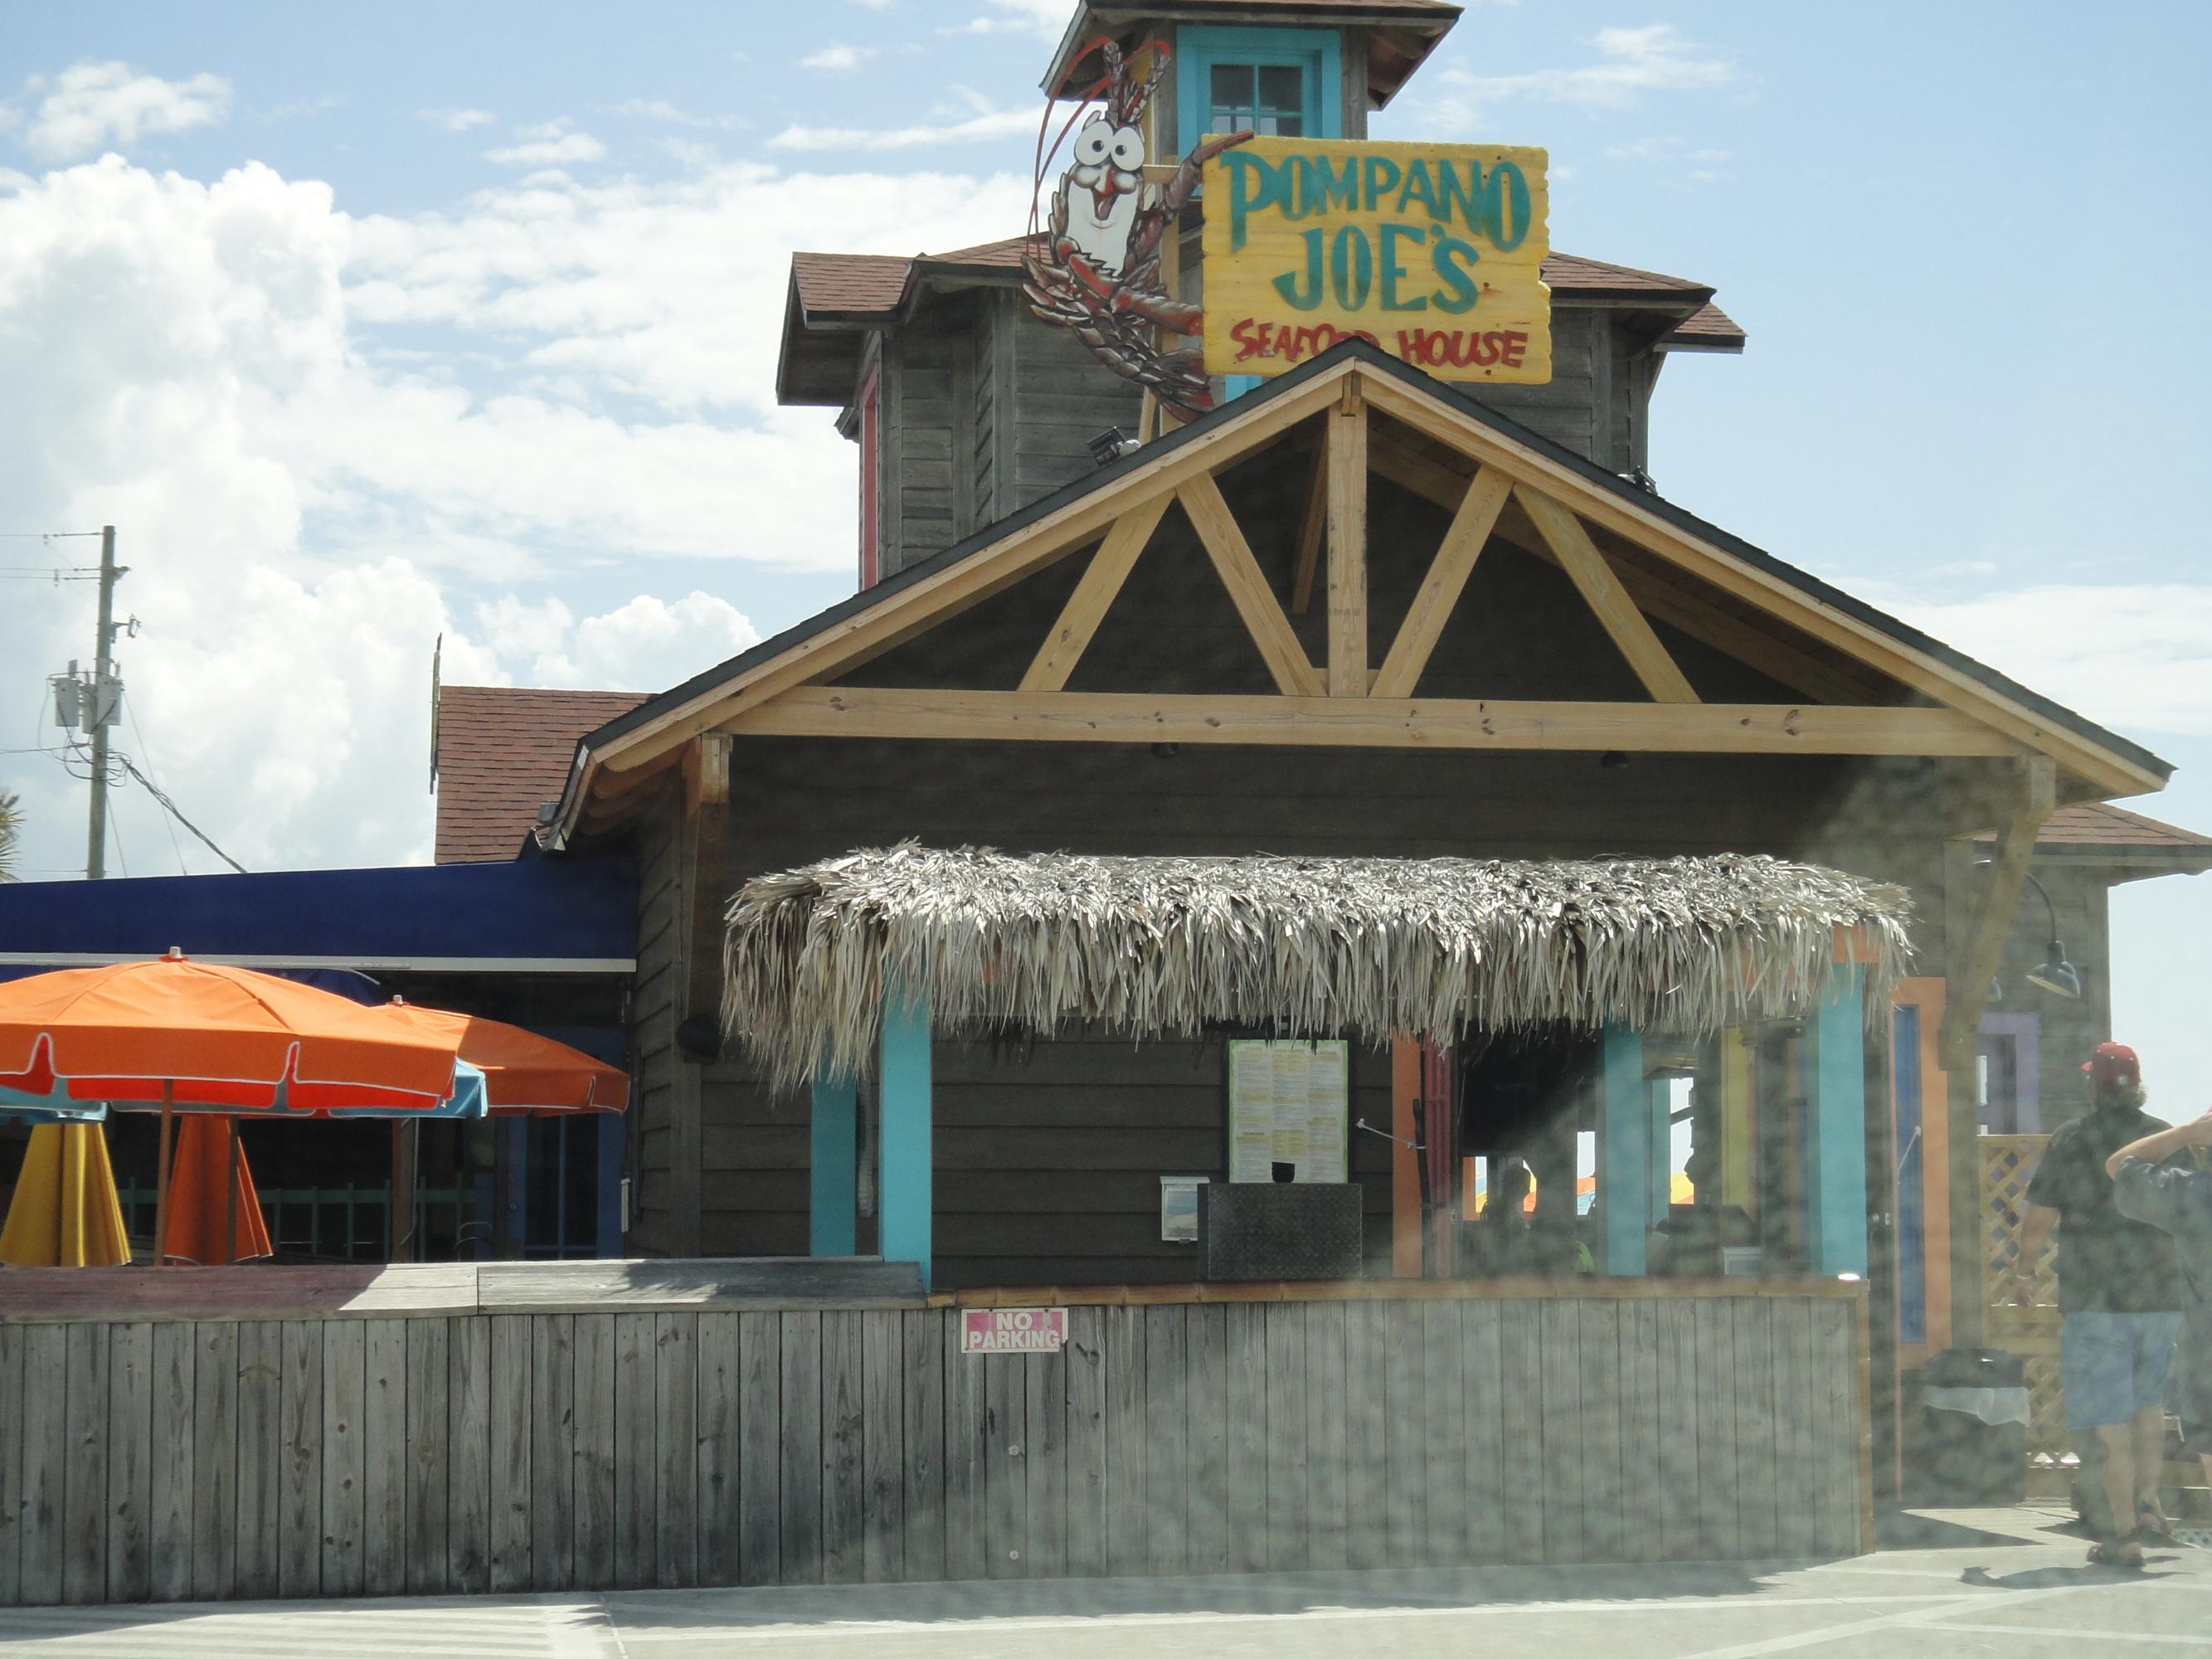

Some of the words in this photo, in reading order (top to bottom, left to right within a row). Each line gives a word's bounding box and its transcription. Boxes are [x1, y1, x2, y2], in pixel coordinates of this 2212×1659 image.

[1220, 150, 1531, 253] POMPANO
[1272, 223, 1480, 314] JOE'S
[1230, 318, 1381, 362] SEAFO
[1398, 328, 1528, 368] HOUSE
[969, 1330, 1061, 1349] PARKING
[996, 1312, 1033, 1331] NO
